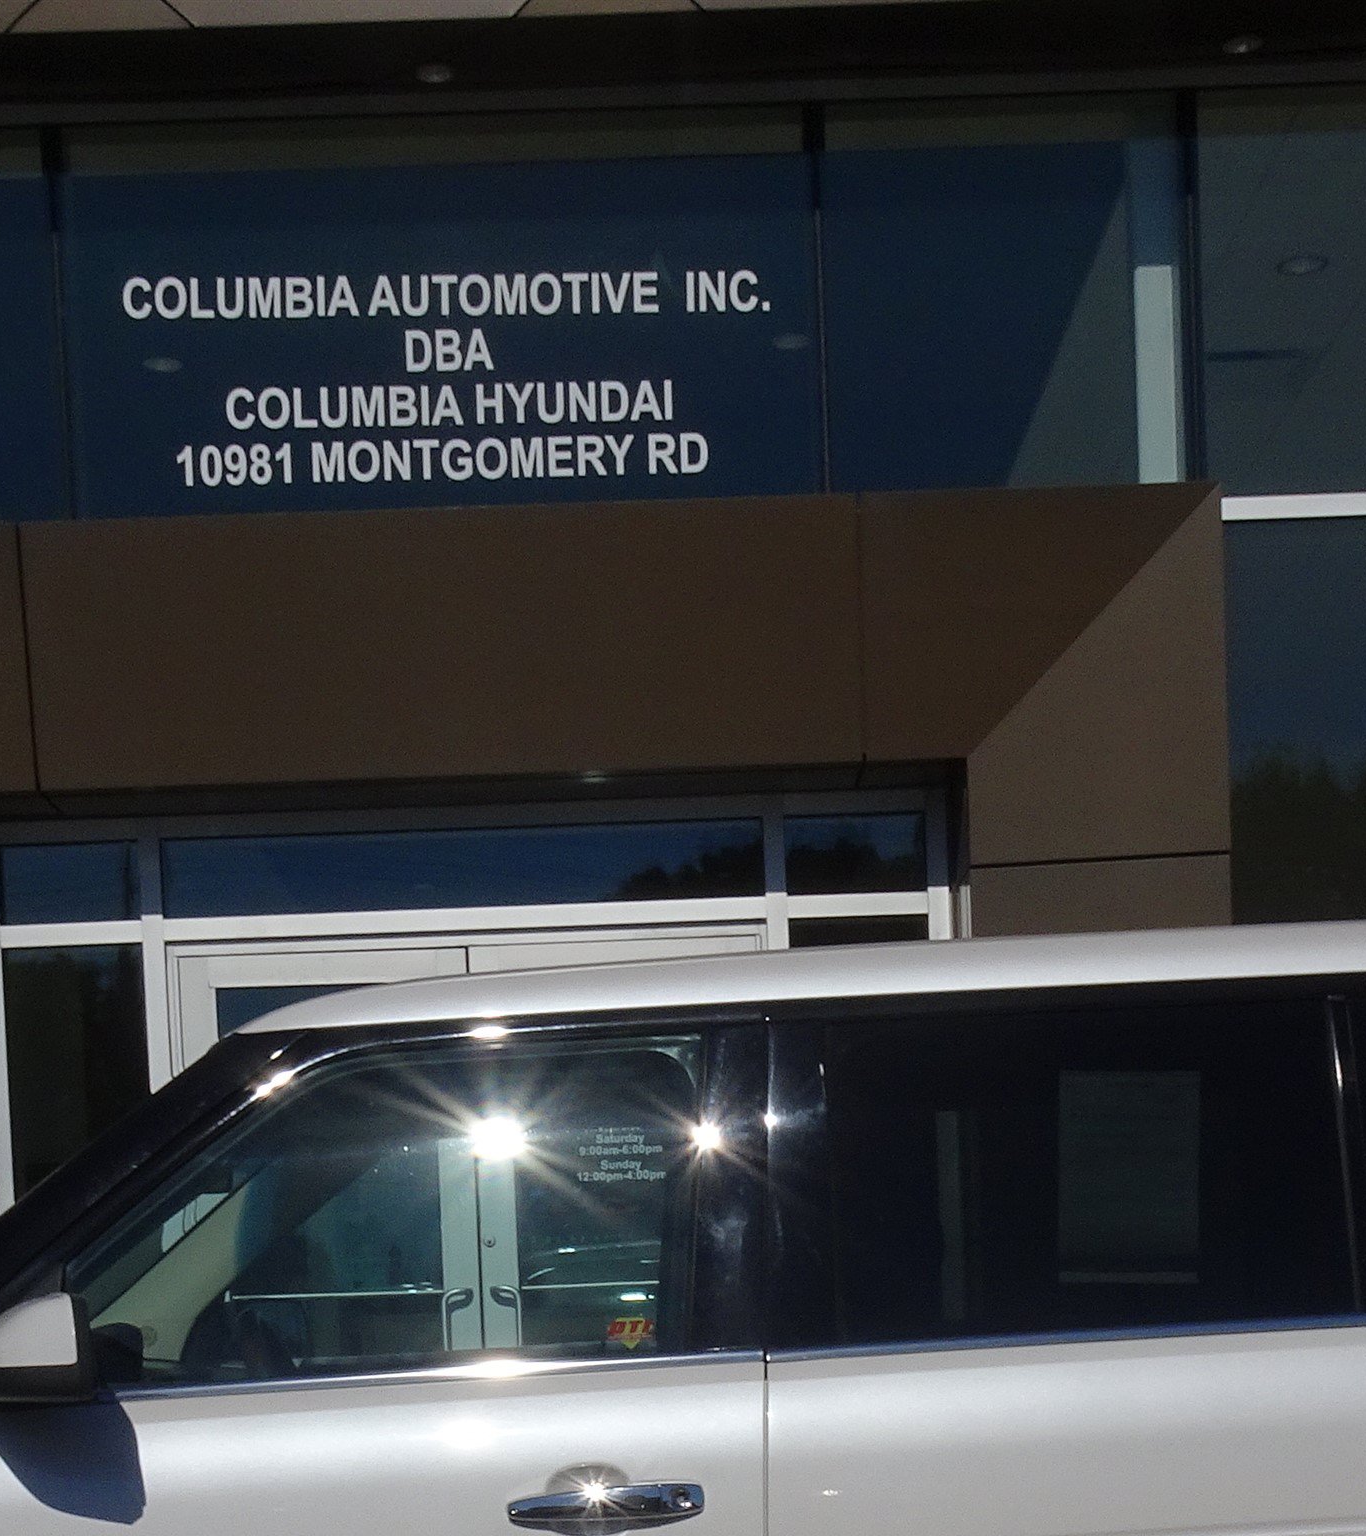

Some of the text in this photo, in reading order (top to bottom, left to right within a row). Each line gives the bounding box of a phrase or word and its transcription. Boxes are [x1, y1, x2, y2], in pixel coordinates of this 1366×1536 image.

[122, 269, 771, 320] COLUMBIA AUTOMOTIVE INC.
[404, 328, 495, 373] DBA
[225, 379, 673, 430] COLUMBIA HYUNDAI
[176, 432, 709, 487] 10981 MONTGOMERY RD
[595, 1134, 645, 1145] Saturday
[600, 1160, 642, 1170] Sunday
